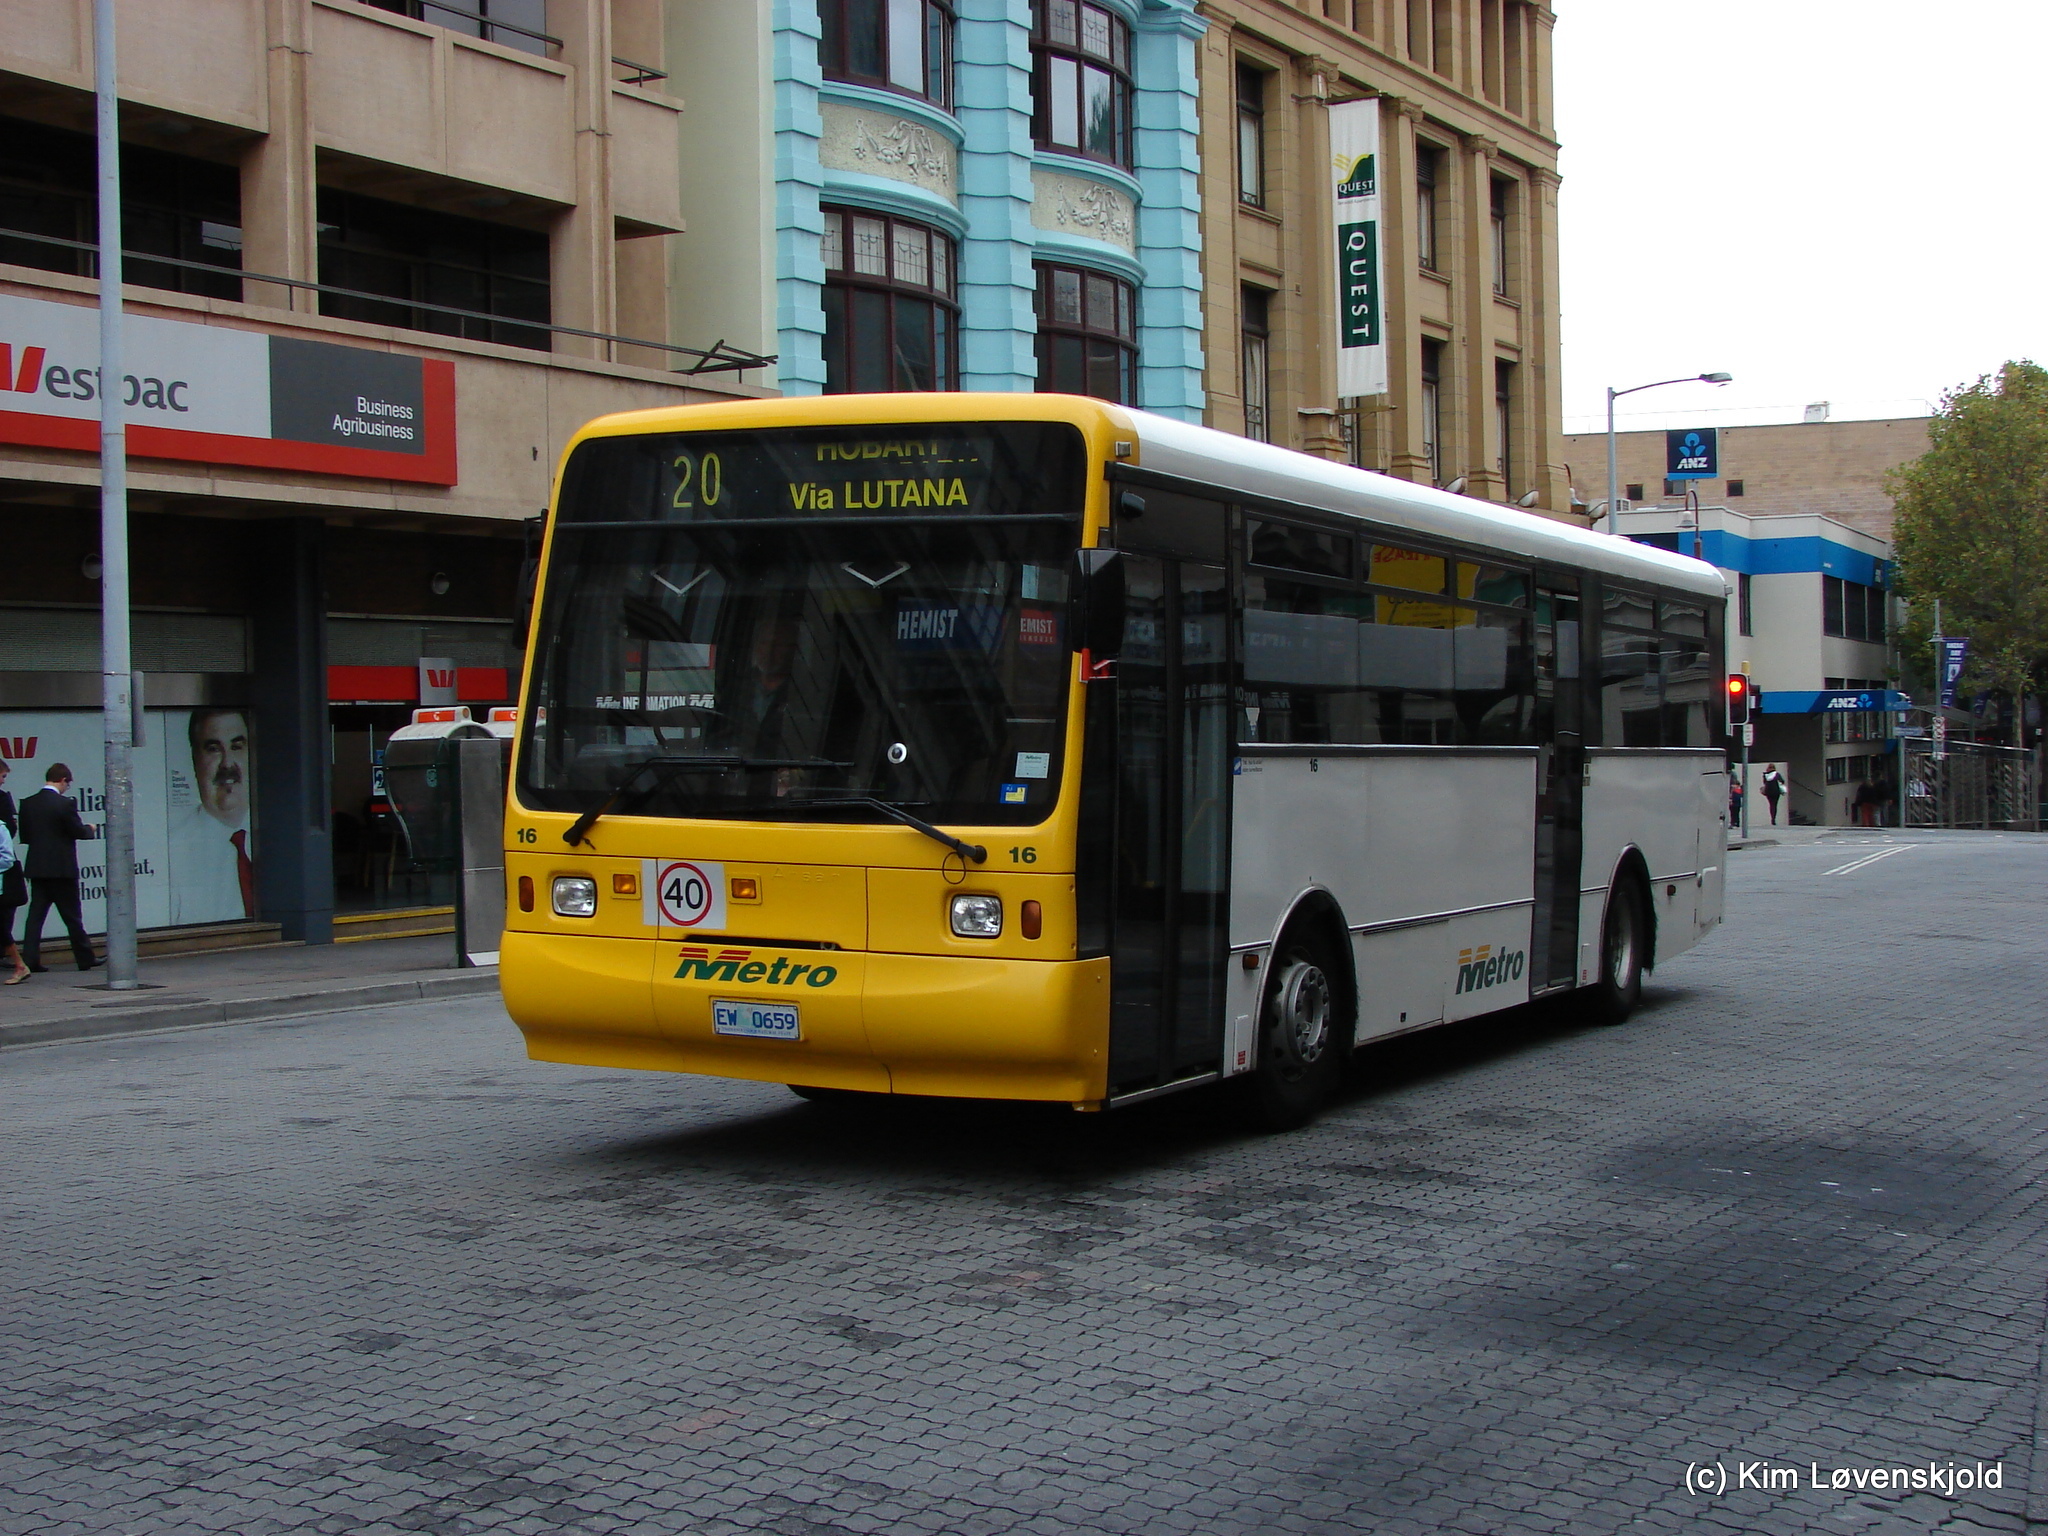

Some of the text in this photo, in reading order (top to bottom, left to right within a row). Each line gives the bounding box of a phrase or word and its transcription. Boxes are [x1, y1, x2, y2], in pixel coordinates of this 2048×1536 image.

[1339, 180, 1373, 194] QUEST
[1346, 231, 1369, 338] QUEST
[357, 396, 414, 420] Business
[333, 414, 414, 440] Agribusiness
[1677, 457, 1708, 469] ANZ
[672, 452, 721, 508] 20
[789, 478, 968, 509] Via LUTANA
[898, 609, 958, 639] HEMIST
[1020, 618, 1053, 634] EMIST
[623, 695, 686, 711] INFRMATION
[1827, 698, 1858, 708] ANZ
[1309, 758, 1318, 772] 16
[517, 828, 537, 843] 16
[1009, 847, 1037, 864] 16
[664, 878, 703, 909] 40
[674, 947, 837, 987] Metro
[1455, 945, 1524, 995] Metro
[716, 1008, 795, 1030] EW 0659
